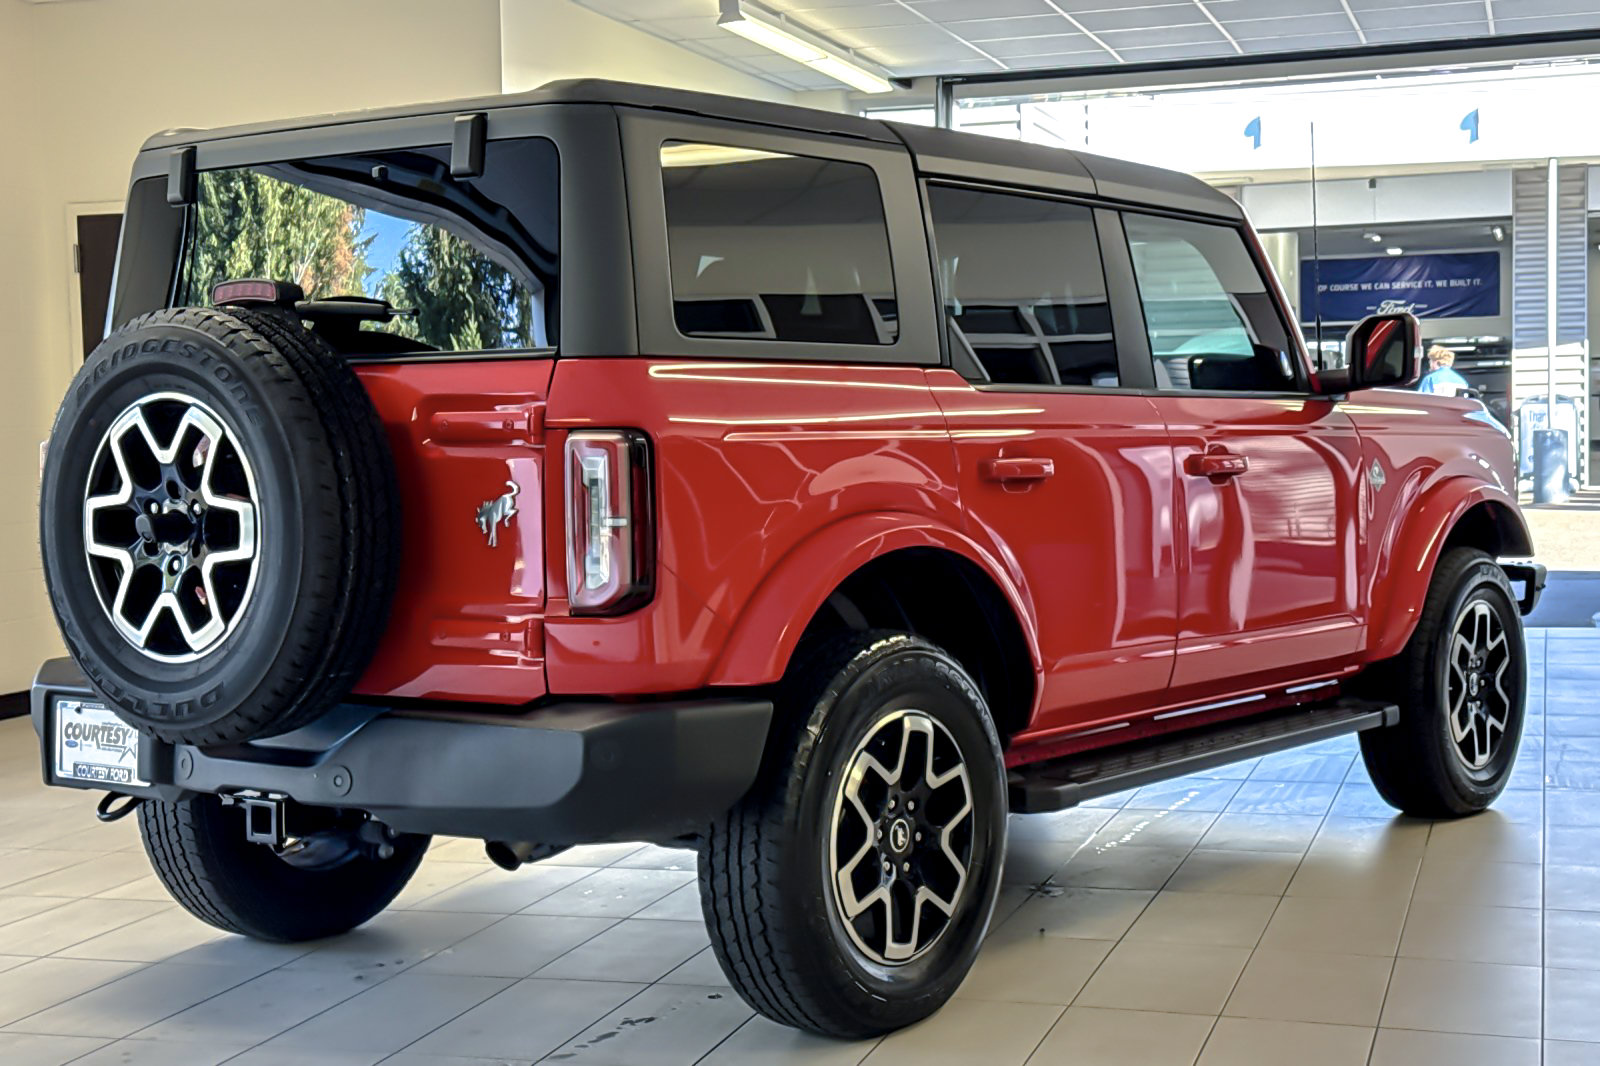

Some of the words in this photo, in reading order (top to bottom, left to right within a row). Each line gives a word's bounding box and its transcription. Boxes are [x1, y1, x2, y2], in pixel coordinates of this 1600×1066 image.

[1330, 283, 1358, 292] COURSE
[1360, 282, 1372, 290] WE
[1374, 282, 1390, 290] CAN
[1392, 280, 1422, 289] SERVICE
[1450, 279, 1471, 287] BUILT
[1377, 300, 1415, 315] Ford
[77, 338, 263, 426] BRIDGESTONE
[64, 722, 130, 749] COURTESY
[77, 765, 109, 779] COURTESY
[110, 768, 129, 782] FORD
